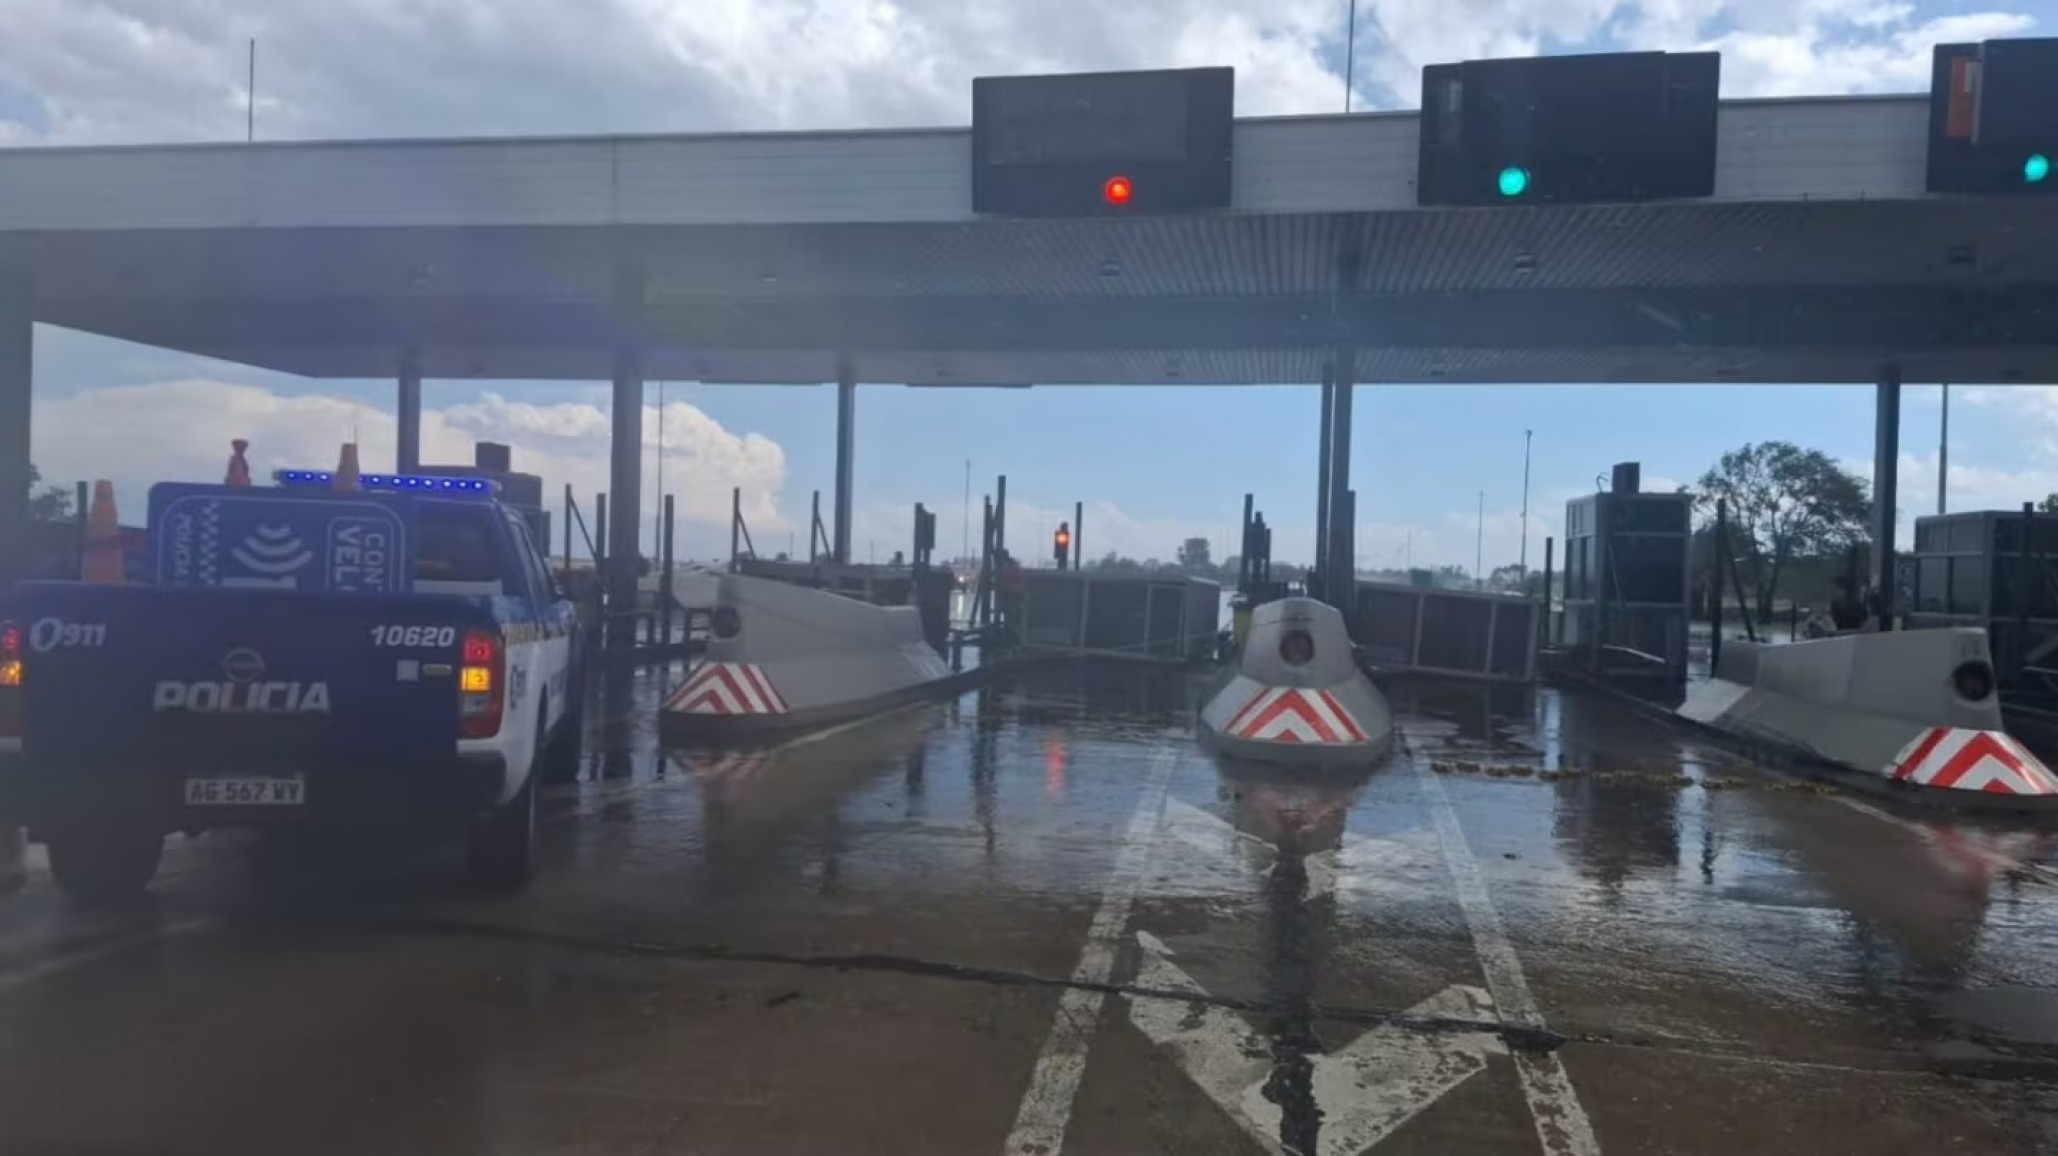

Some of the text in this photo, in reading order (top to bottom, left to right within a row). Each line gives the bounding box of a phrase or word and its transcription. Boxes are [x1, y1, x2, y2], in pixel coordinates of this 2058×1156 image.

[364, 533, 384, 591] CON
[371, 624, 456, 647] 10620
[153, 680, 330, 714] POLICIA
[191, 781, 217, 801] AG
[225, 781, 266, 801] 567
